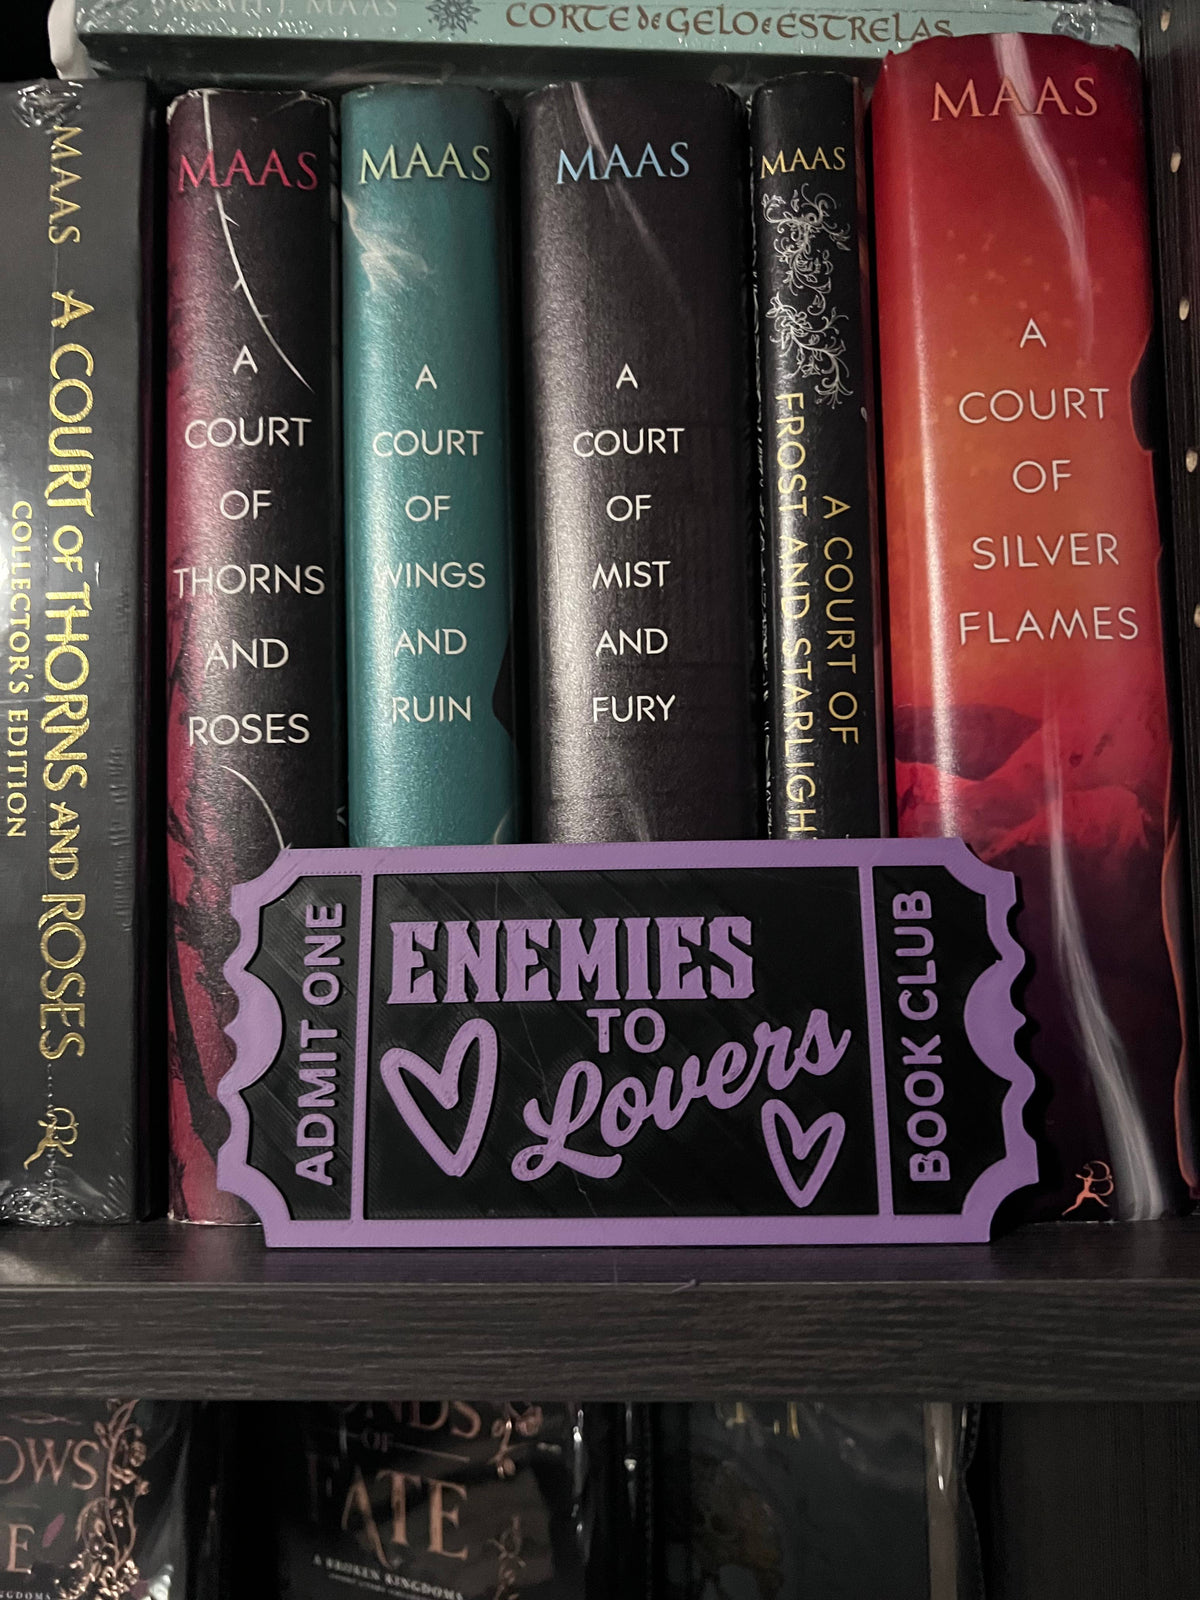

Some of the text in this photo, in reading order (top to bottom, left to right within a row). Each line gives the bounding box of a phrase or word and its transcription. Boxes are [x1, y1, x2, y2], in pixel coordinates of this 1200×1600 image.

[506, 2, 629, 33] CORTE
[665, 4, 760, 37] GELO
[776, 12, 952, 43] ESTRELAS
[930, 75, 1099, 122] MAAS
[177, 149, 319, 193] MAAS
[358, 142, 491, 185] MAAS
[555, 142, 690, 186] MAAS
[760, 146, 847, 179] MAAS
[1020, 318, 1047, 348] A
[232, 344, 259, 375] A
[415, 363, 438, 390] A
[615, 363, 639, 390] A
[959, 387, 1110, 425] COURT
[184, 416, 312, 450] COURT
[372, 429, 484, 457] COURT
[573, 427, 685, 458] COURT
[1012, 458, 1072, 494] OF
[219, 489, 272, 521] OF
[405, 495, 451, 522] OF
[605, 494, 652, 521] OF
[972, 532, 1119, 571] SILVER
[38, 125, 95, 1060] MAAS A COURT OF THORNS AND ROSES
[172, 563, 326, 599] THORNS
[381, 561, 486, 590] WINGS
[592, 560, 671, 589] MIST
[775, 391, 818, 841] FROST AND STARLIGH
[822, 495, 859, 745] A COURT OF
[959, 606, 1139, 646] FLAMES
[205, 637, 290, 676] AND
[393, 628, 467, 657] AND
[596, 628, 668, 658] AND
[6, 500, 34, 839] COLLECTOR'S EDITION
[391, 695, 472, 724] RUIN
[592, 694, 676, 723] FURY
[188, 713, 310, 748] ROSES
[386, 915, 755, 1005] ENEMIES
[295, 902, 343, 1187] ADMIT ONE
[586, 1008, 667, 1054] TO
[892, 890, 952, 1183] BOOK CLUB
[511, 1008, 852, 1183] Lovers
[0, 1435, 99, 1491] OWS
[314, 1457, 469, 1570] ATE
